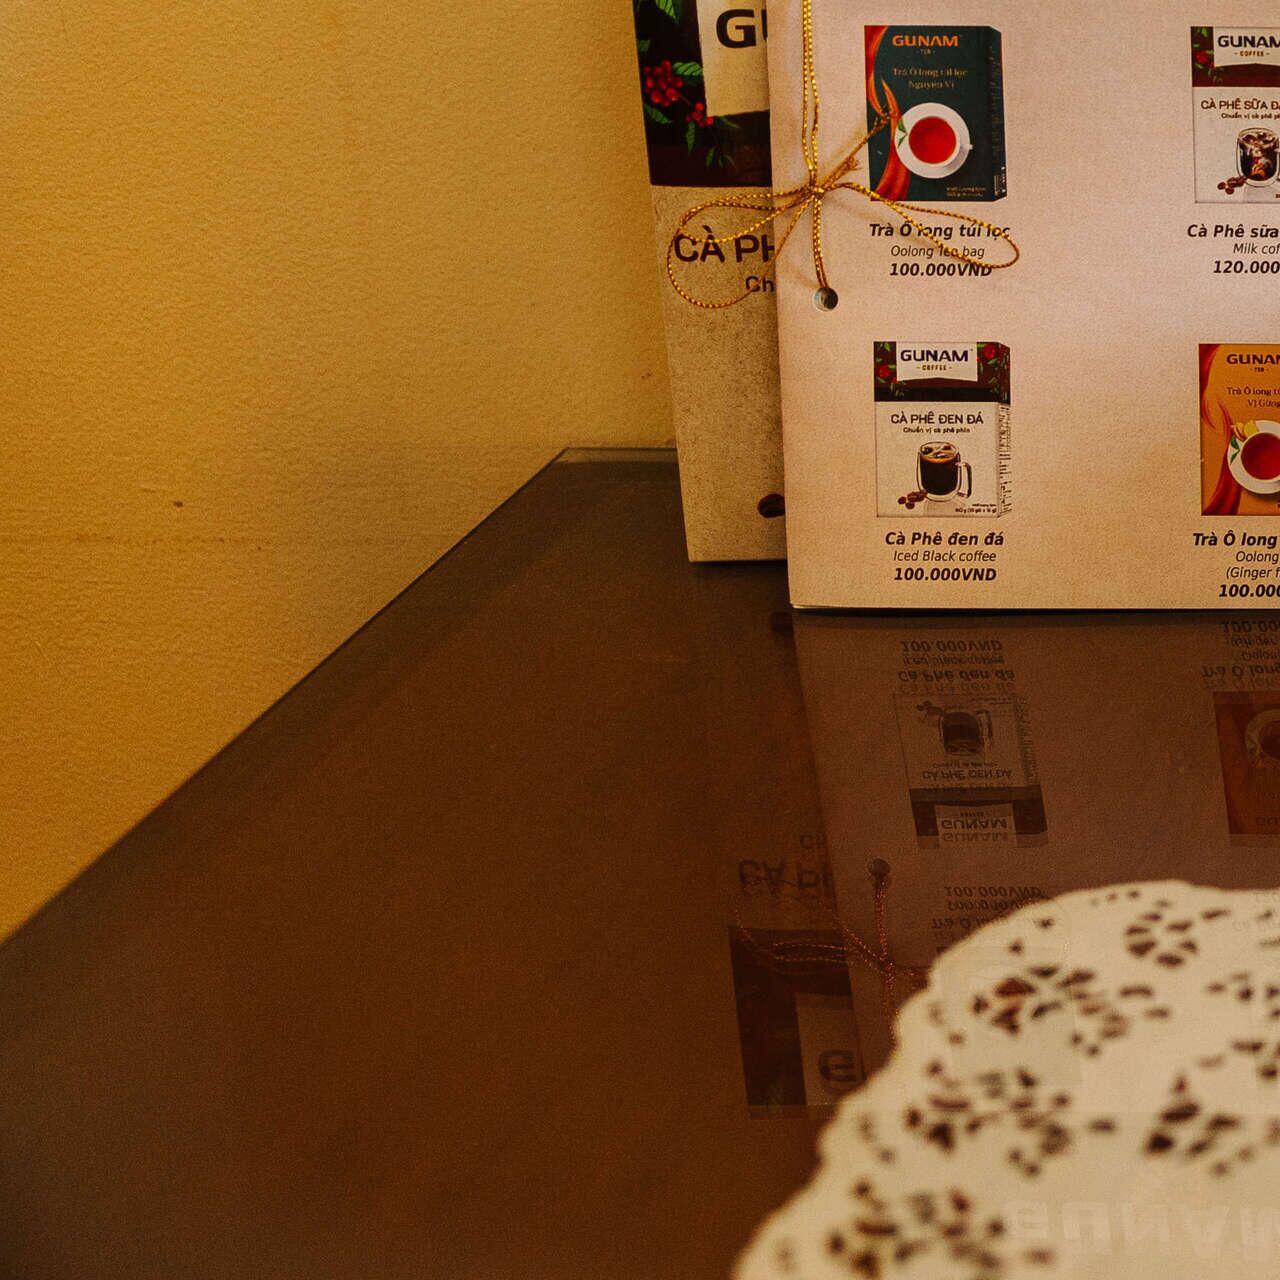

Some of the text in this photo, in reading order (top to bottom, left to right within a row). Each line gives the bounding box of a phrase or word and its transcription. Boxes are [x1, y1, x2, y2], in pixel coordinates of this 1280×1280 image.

[892, 35, 959, 47] GUNAM
[869, 223, 894, 237] Trà
[959, 220, 981, 237] túi
[1187, 223, 1207, 238] Cà
[1213, 223, 1245, 238] Phê
[1250, 224, 1280, 238] sữa
[891, 245, 934, 259] Oolong
[963, 246, 985, 259] bag
[1233, 243, 1258, 254] Milk
[889, 263, 993, 277] 100.000VND
[900, 350, 969, 362] GUNAM
[891, 411, 984, 424] CÀ PHÊ ĐEN ĐÁ
[885, 531, 1004, 546] Cà Phê đen đá
[1193, 531, 1218, 546] Trà
[1223, 530, 1236, 546] Ô
[1241, 532, 1277, 549] long
[893, 550, 997, 562] Iced Black coffee
[1235, 551, 1279, 564] Oolong
[894, 567, 997, 581] 100.000VND
[1226, 567, 1272, 580] (Ginger
